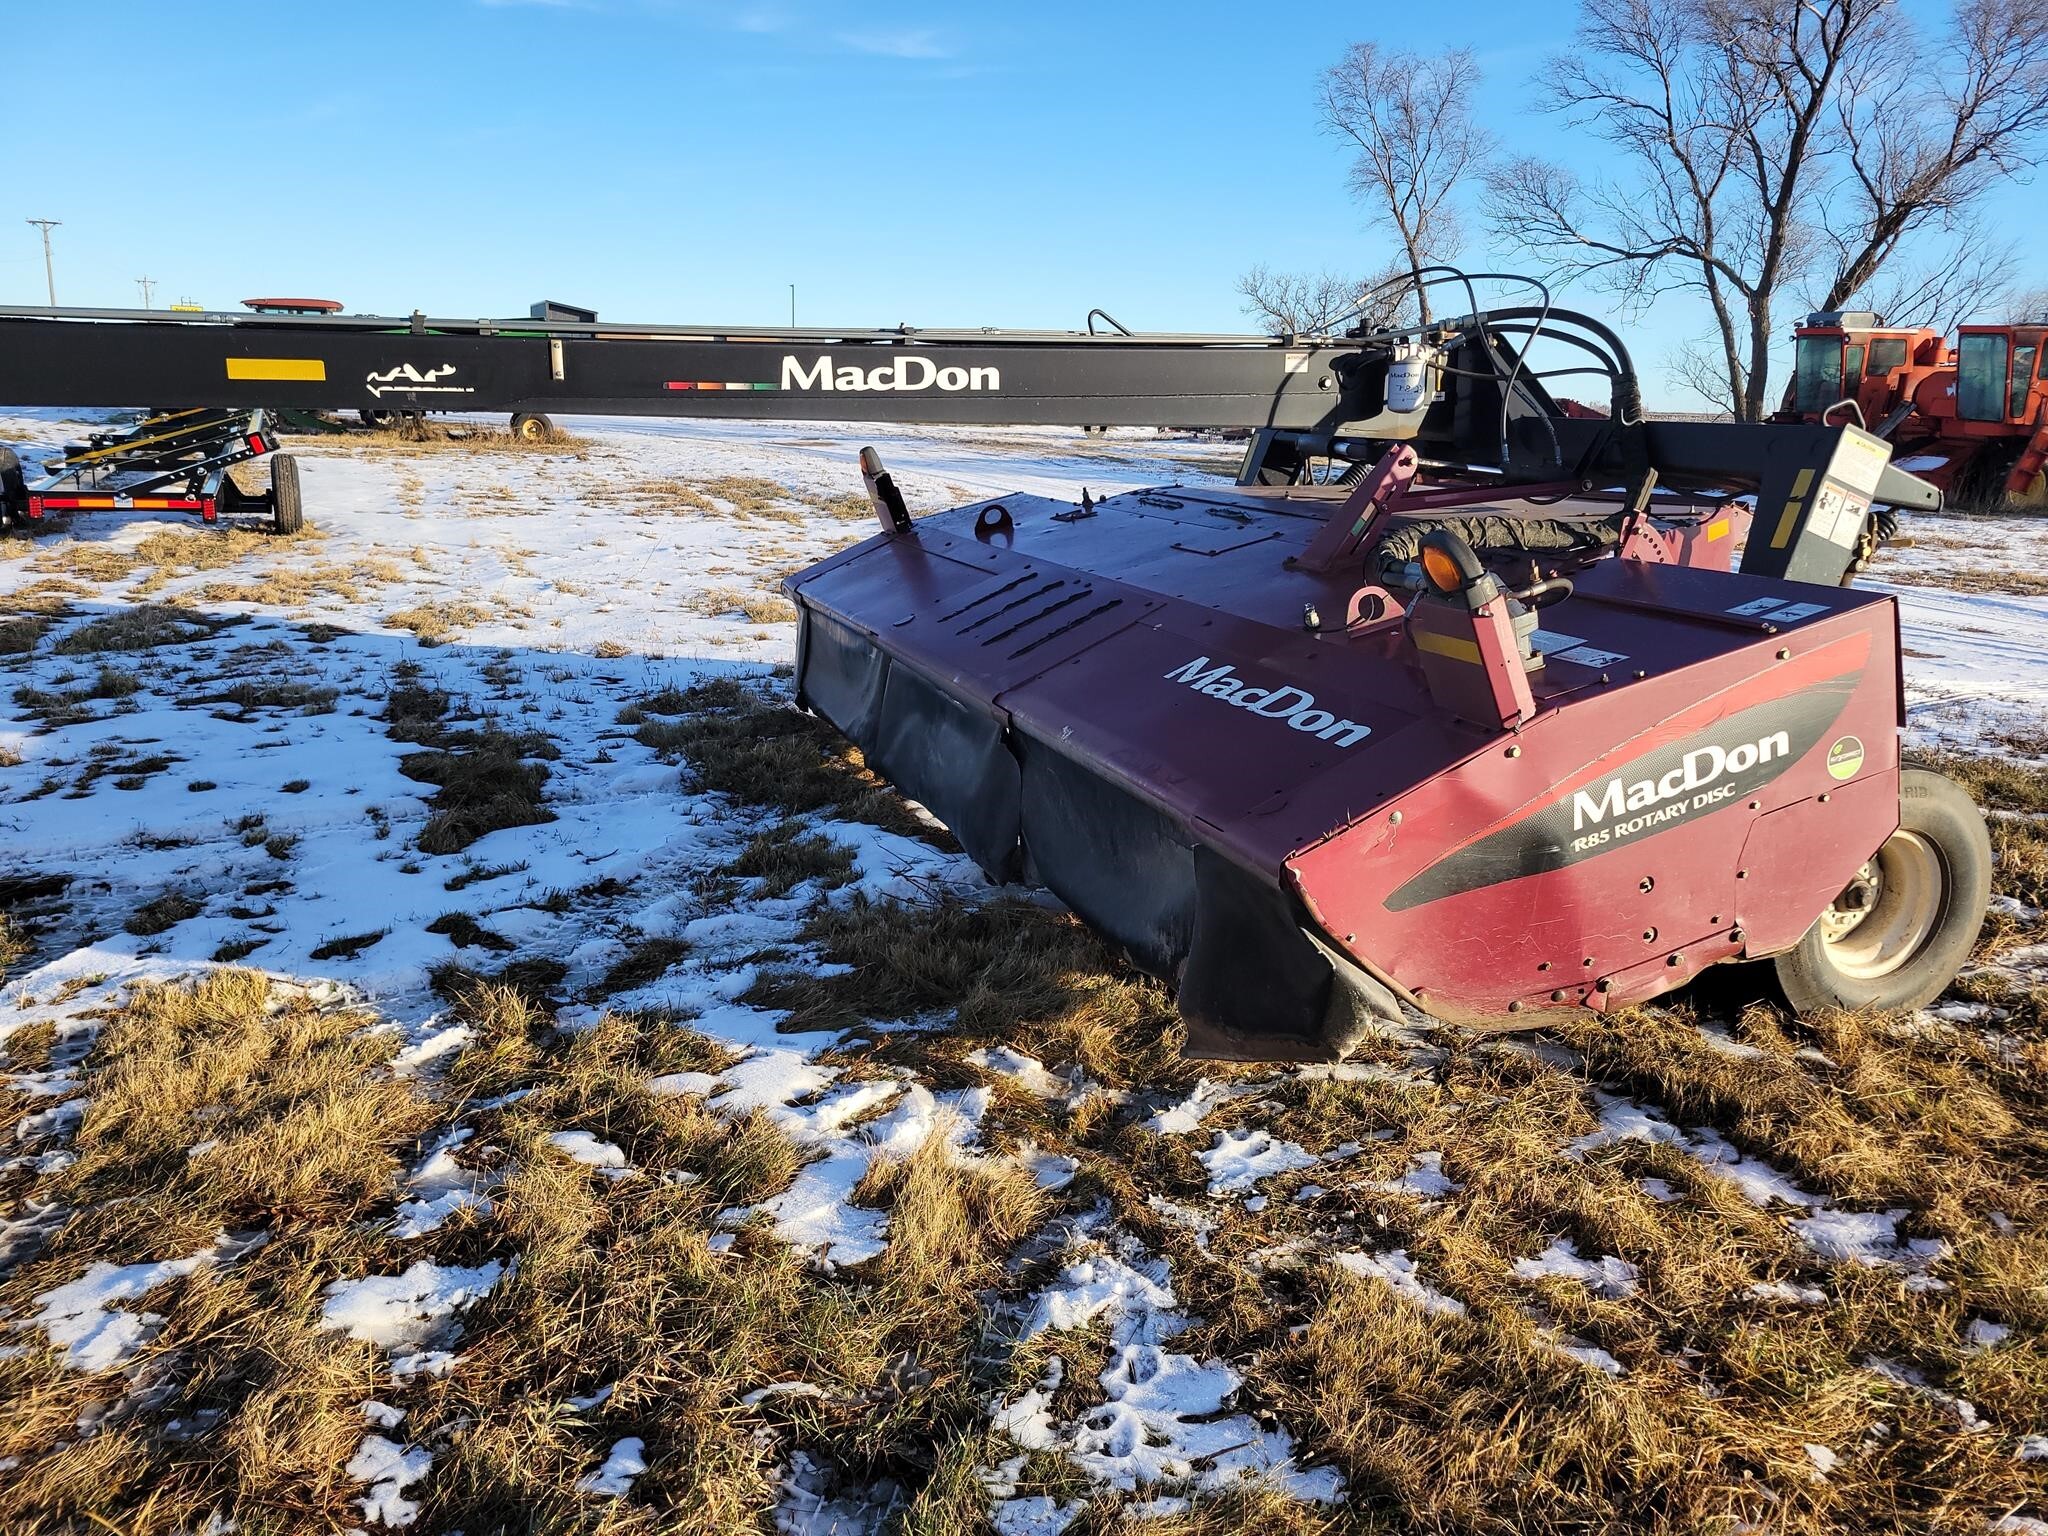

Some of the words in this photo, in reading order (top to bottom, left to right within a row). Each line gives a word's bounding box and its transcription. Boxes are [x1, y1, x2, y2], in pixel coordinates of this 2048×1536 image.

[781, 355, 1000, 392] MacDon
[1163, 656, 1372, 748] MacDon
[1571, 831, 1611, 852] R85
[1614, 799, 1691, 839] ROTARY
[1693, 783, 1737, 810] DISC
[1573, 731, 1790, 831] MacDon
